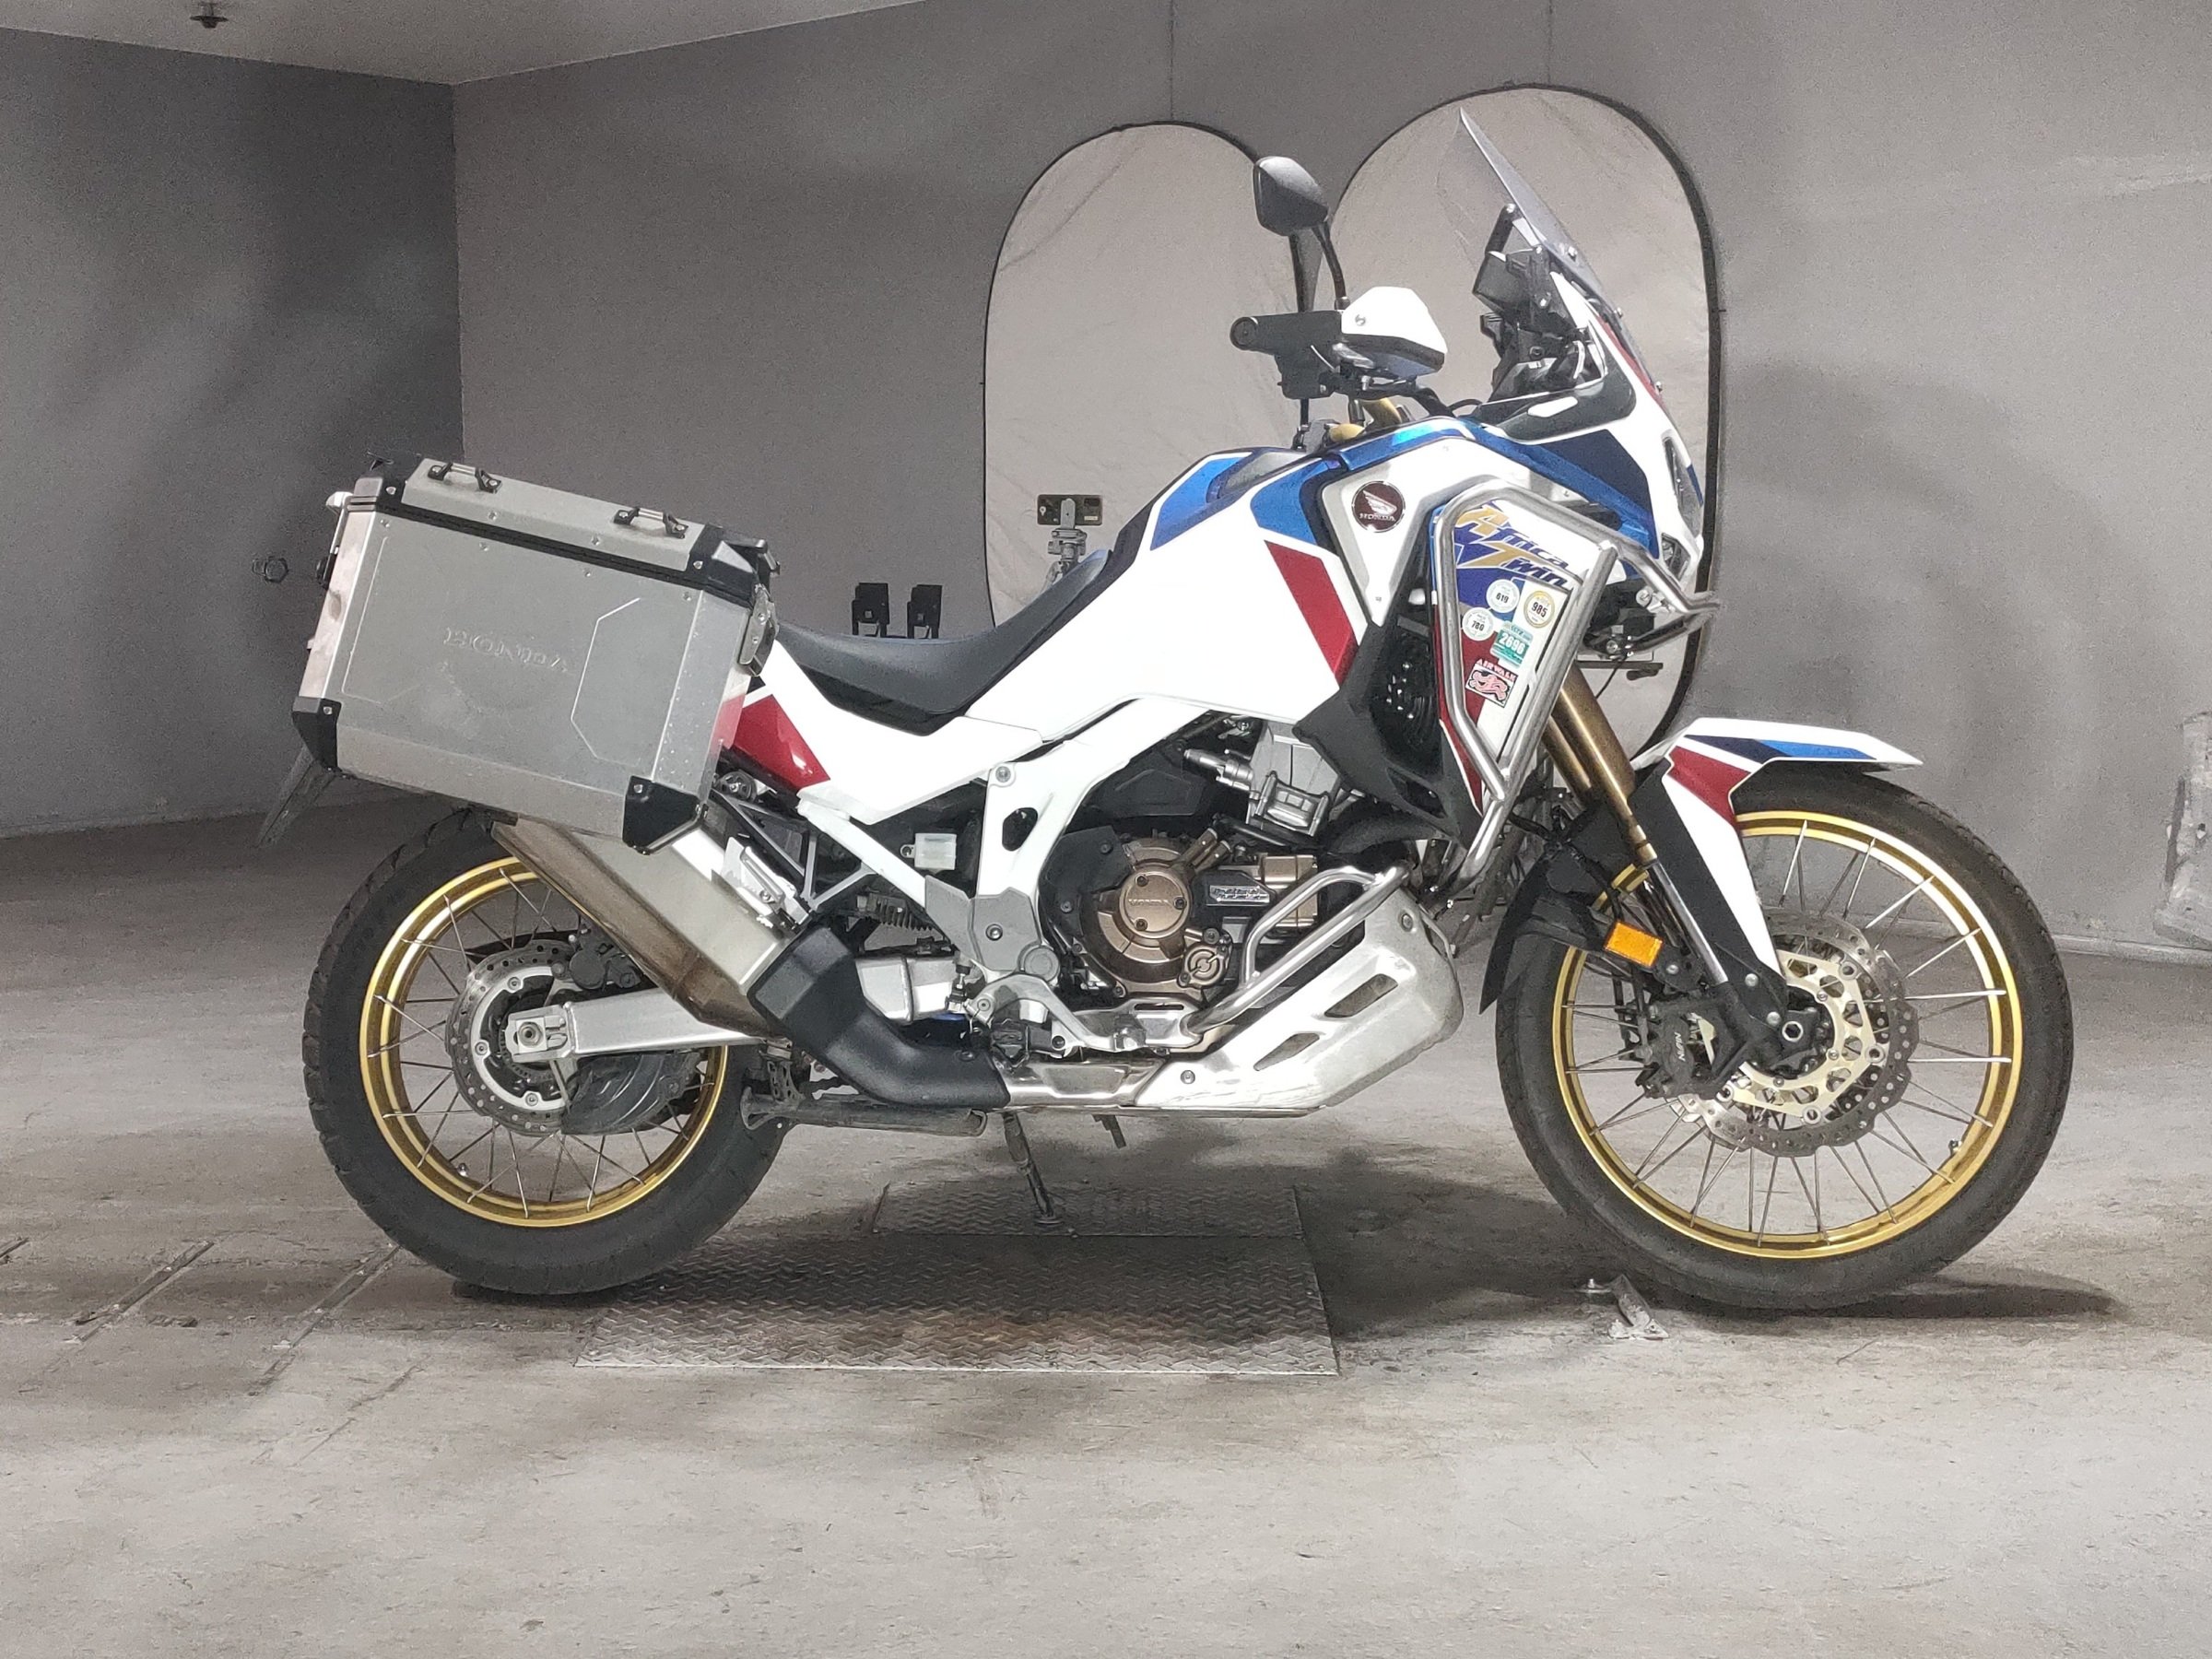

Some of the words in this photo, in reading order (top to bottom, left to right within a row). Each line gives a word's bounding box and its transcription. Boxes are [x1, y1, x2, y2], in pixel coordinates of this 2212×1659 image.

[1359, 512, 1396, 522] HONDA
[1456, 540, 1583, 588] Twin
[1531, 602, 1548, 618] 985
